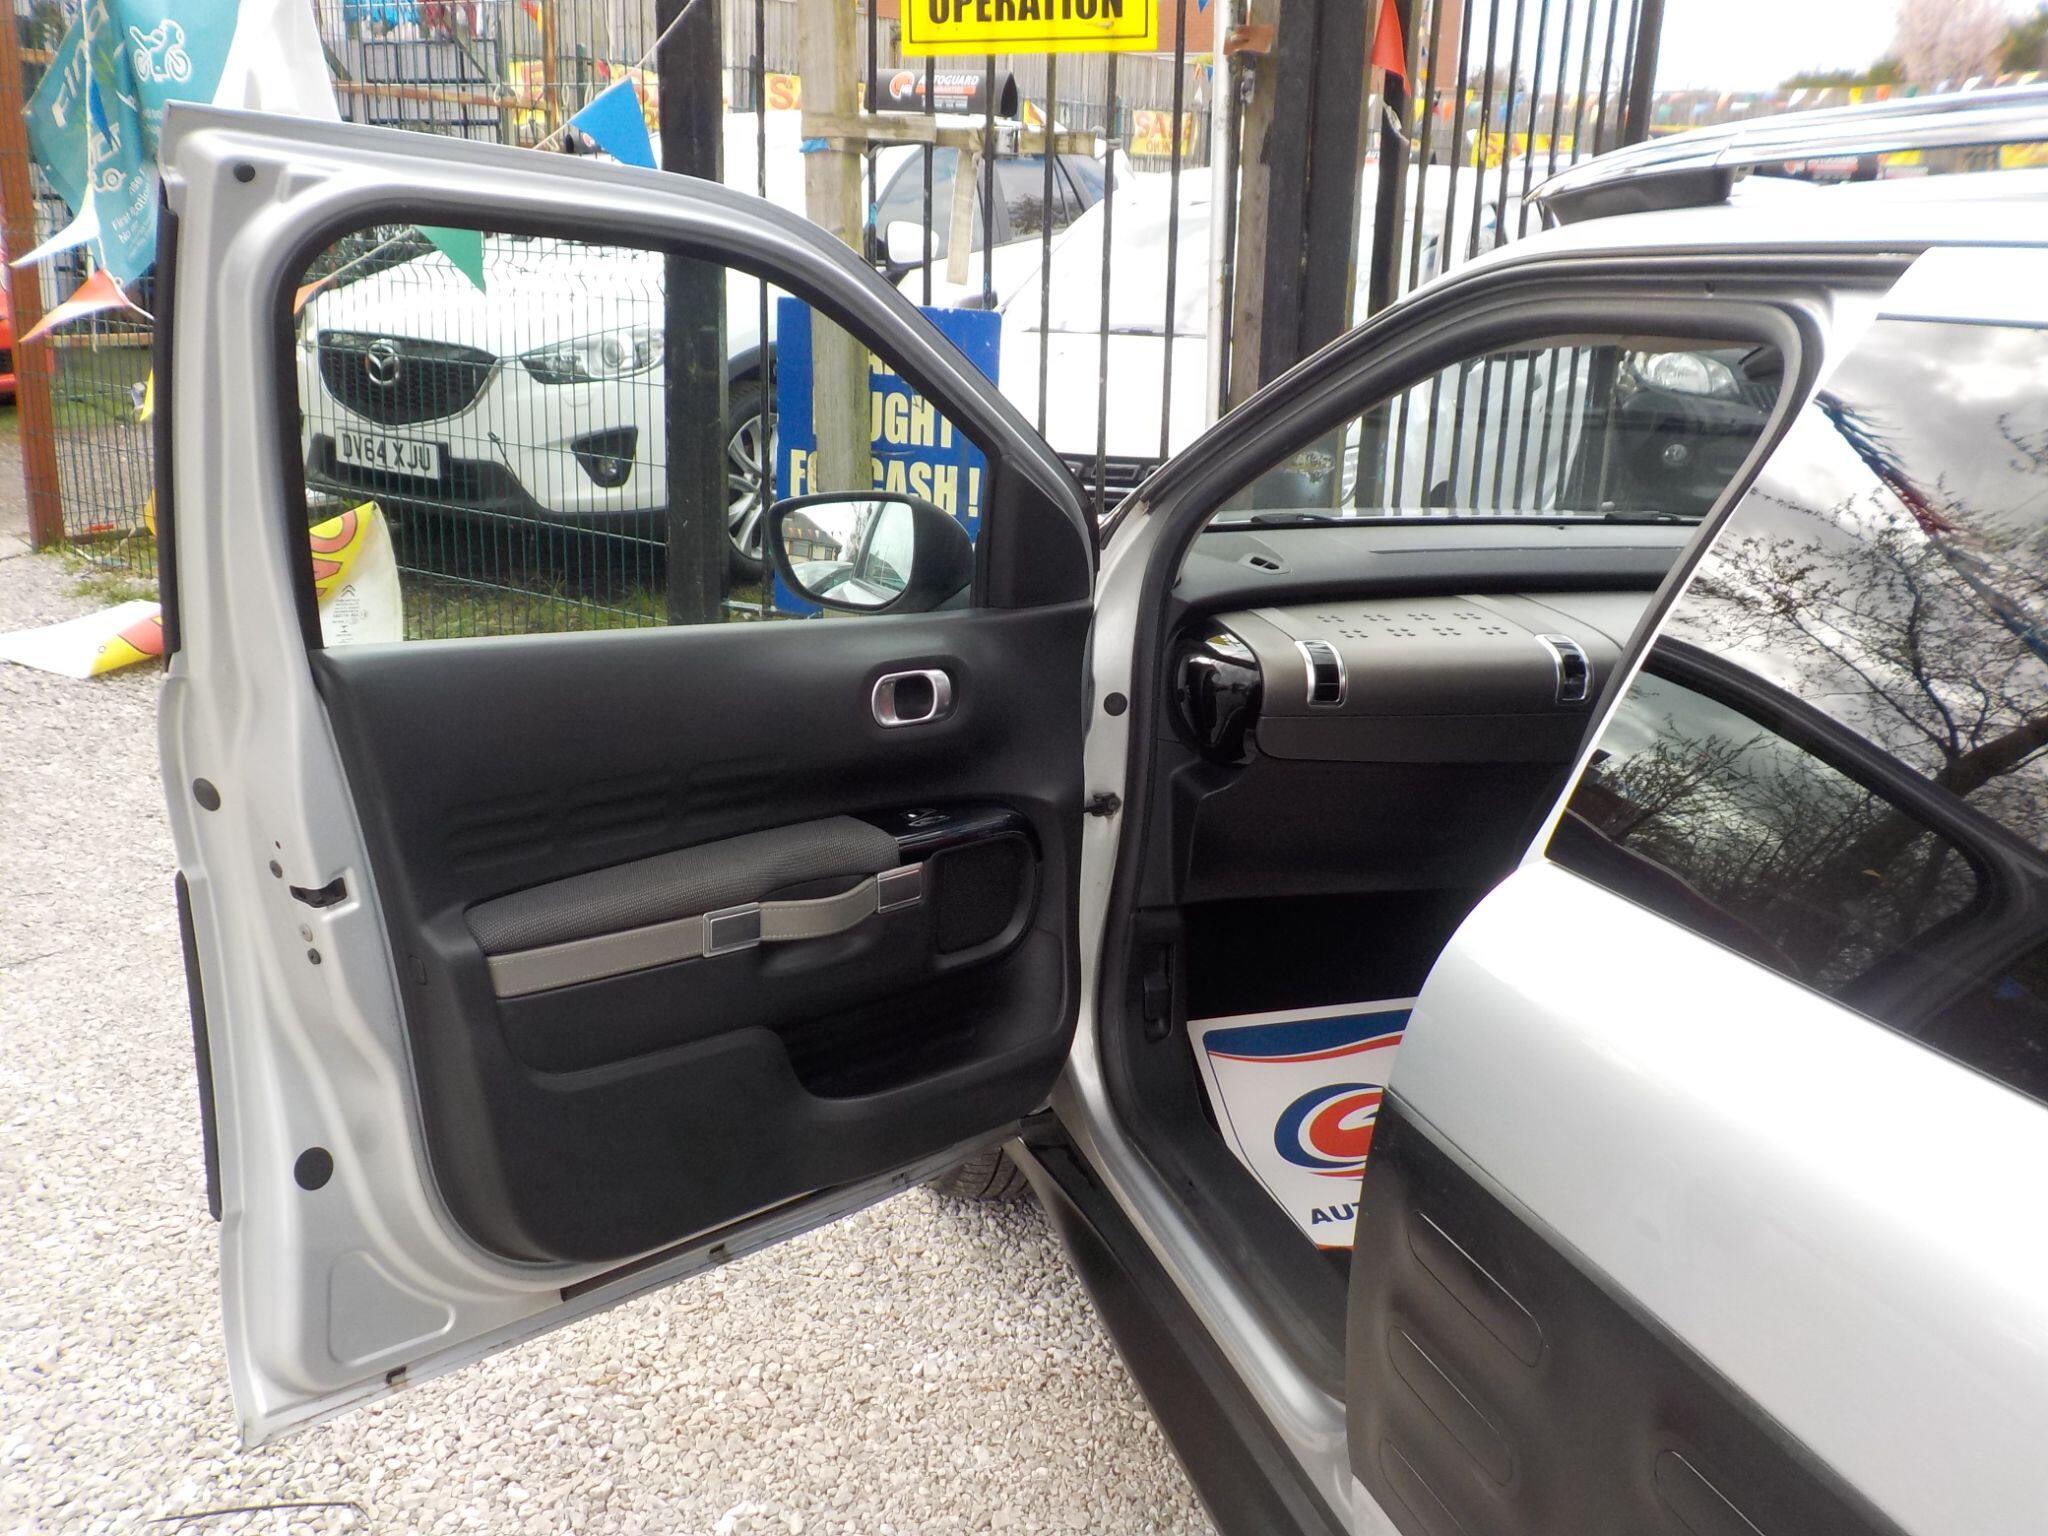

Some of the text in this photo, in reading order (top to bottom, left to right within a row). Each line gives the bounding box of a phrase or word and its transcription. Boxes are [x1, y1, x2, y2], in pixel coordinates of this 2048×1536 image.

[928, 0, 1123, 24] OPERATION
[342, 433, 431, 471] DV64 XJU
